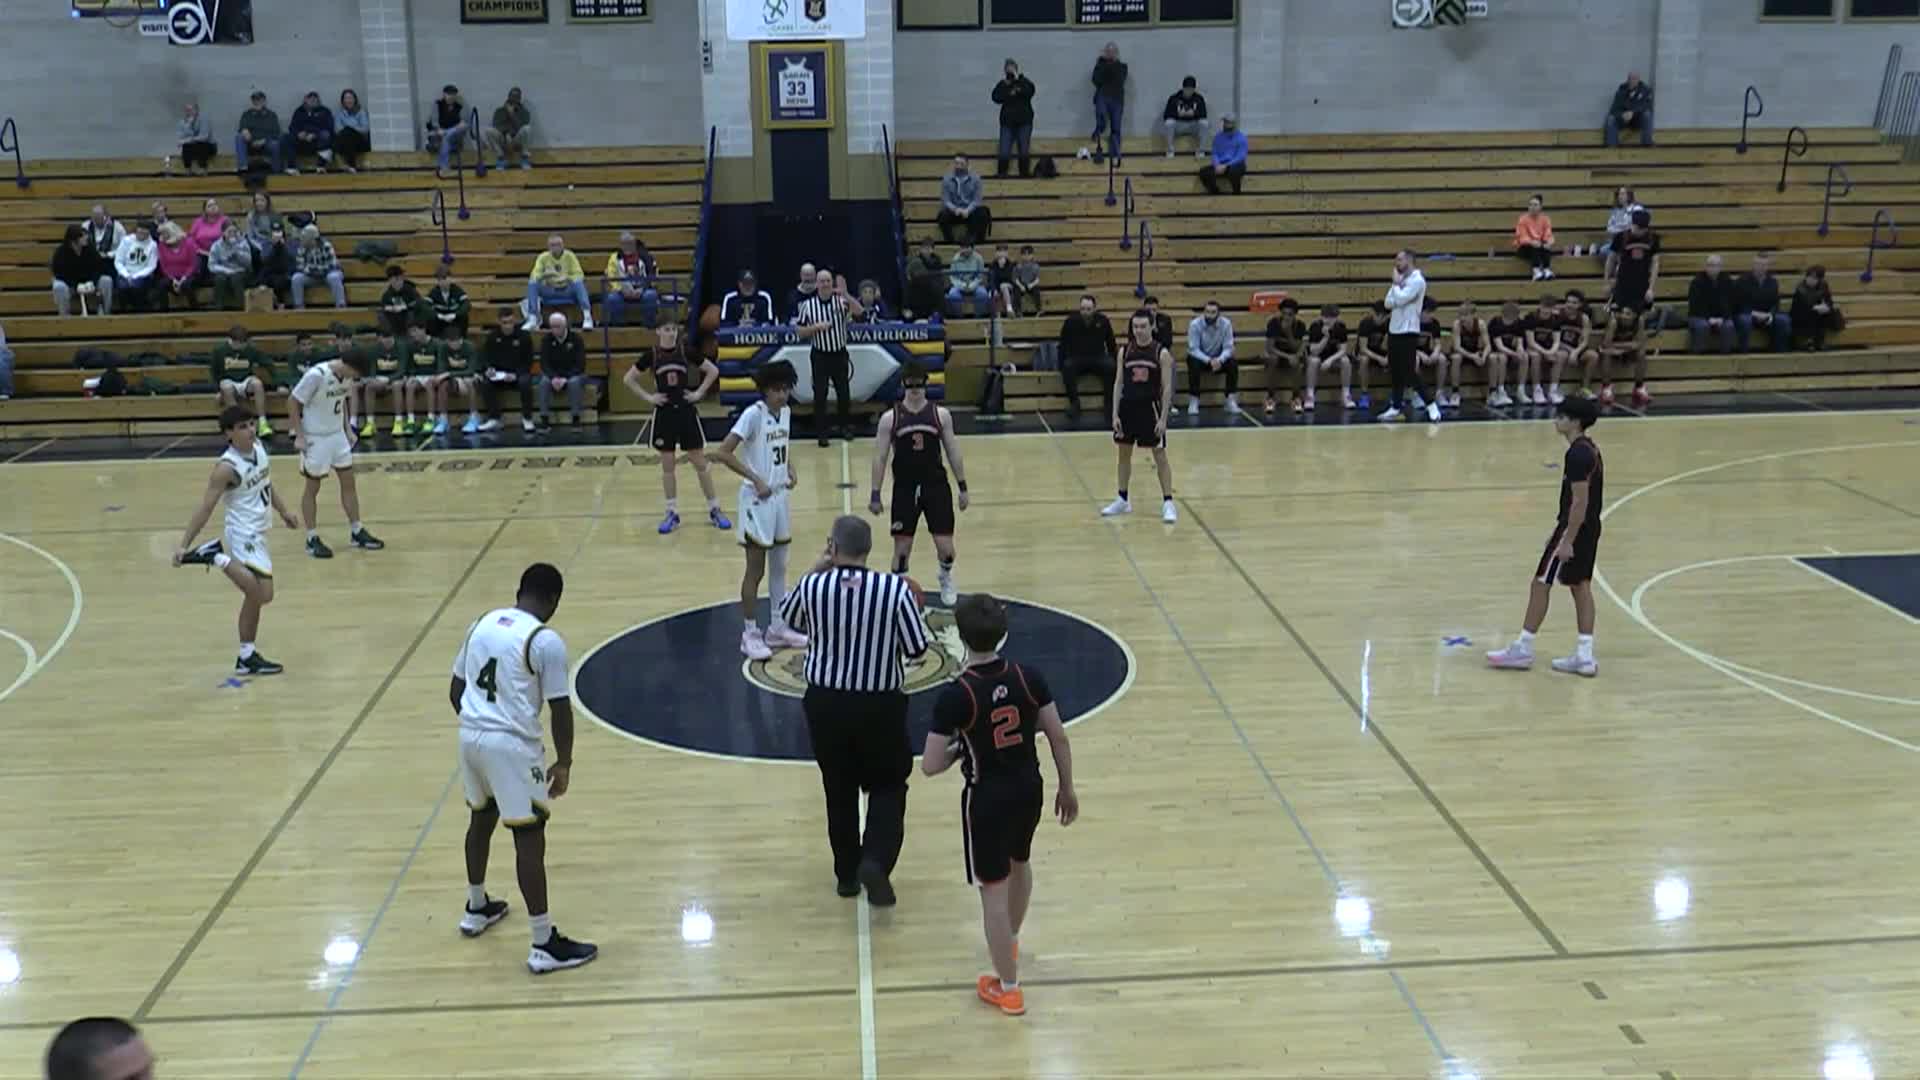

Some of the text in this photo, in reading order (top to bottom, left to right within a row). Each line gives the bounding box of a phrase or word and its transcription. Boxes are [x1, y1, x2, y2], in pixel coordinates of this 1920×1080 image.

[468, 0, 541, 12] CHAMPIONS
[787, 80, 806, 97] 33
[735, 330, 778, 345] HOME
[850, 327, 929, 342] WARRIORS
[912, 432, 924, 450] 3
[476, 657, 498, 703] 4
[991, 705, 1023, 749] 2
